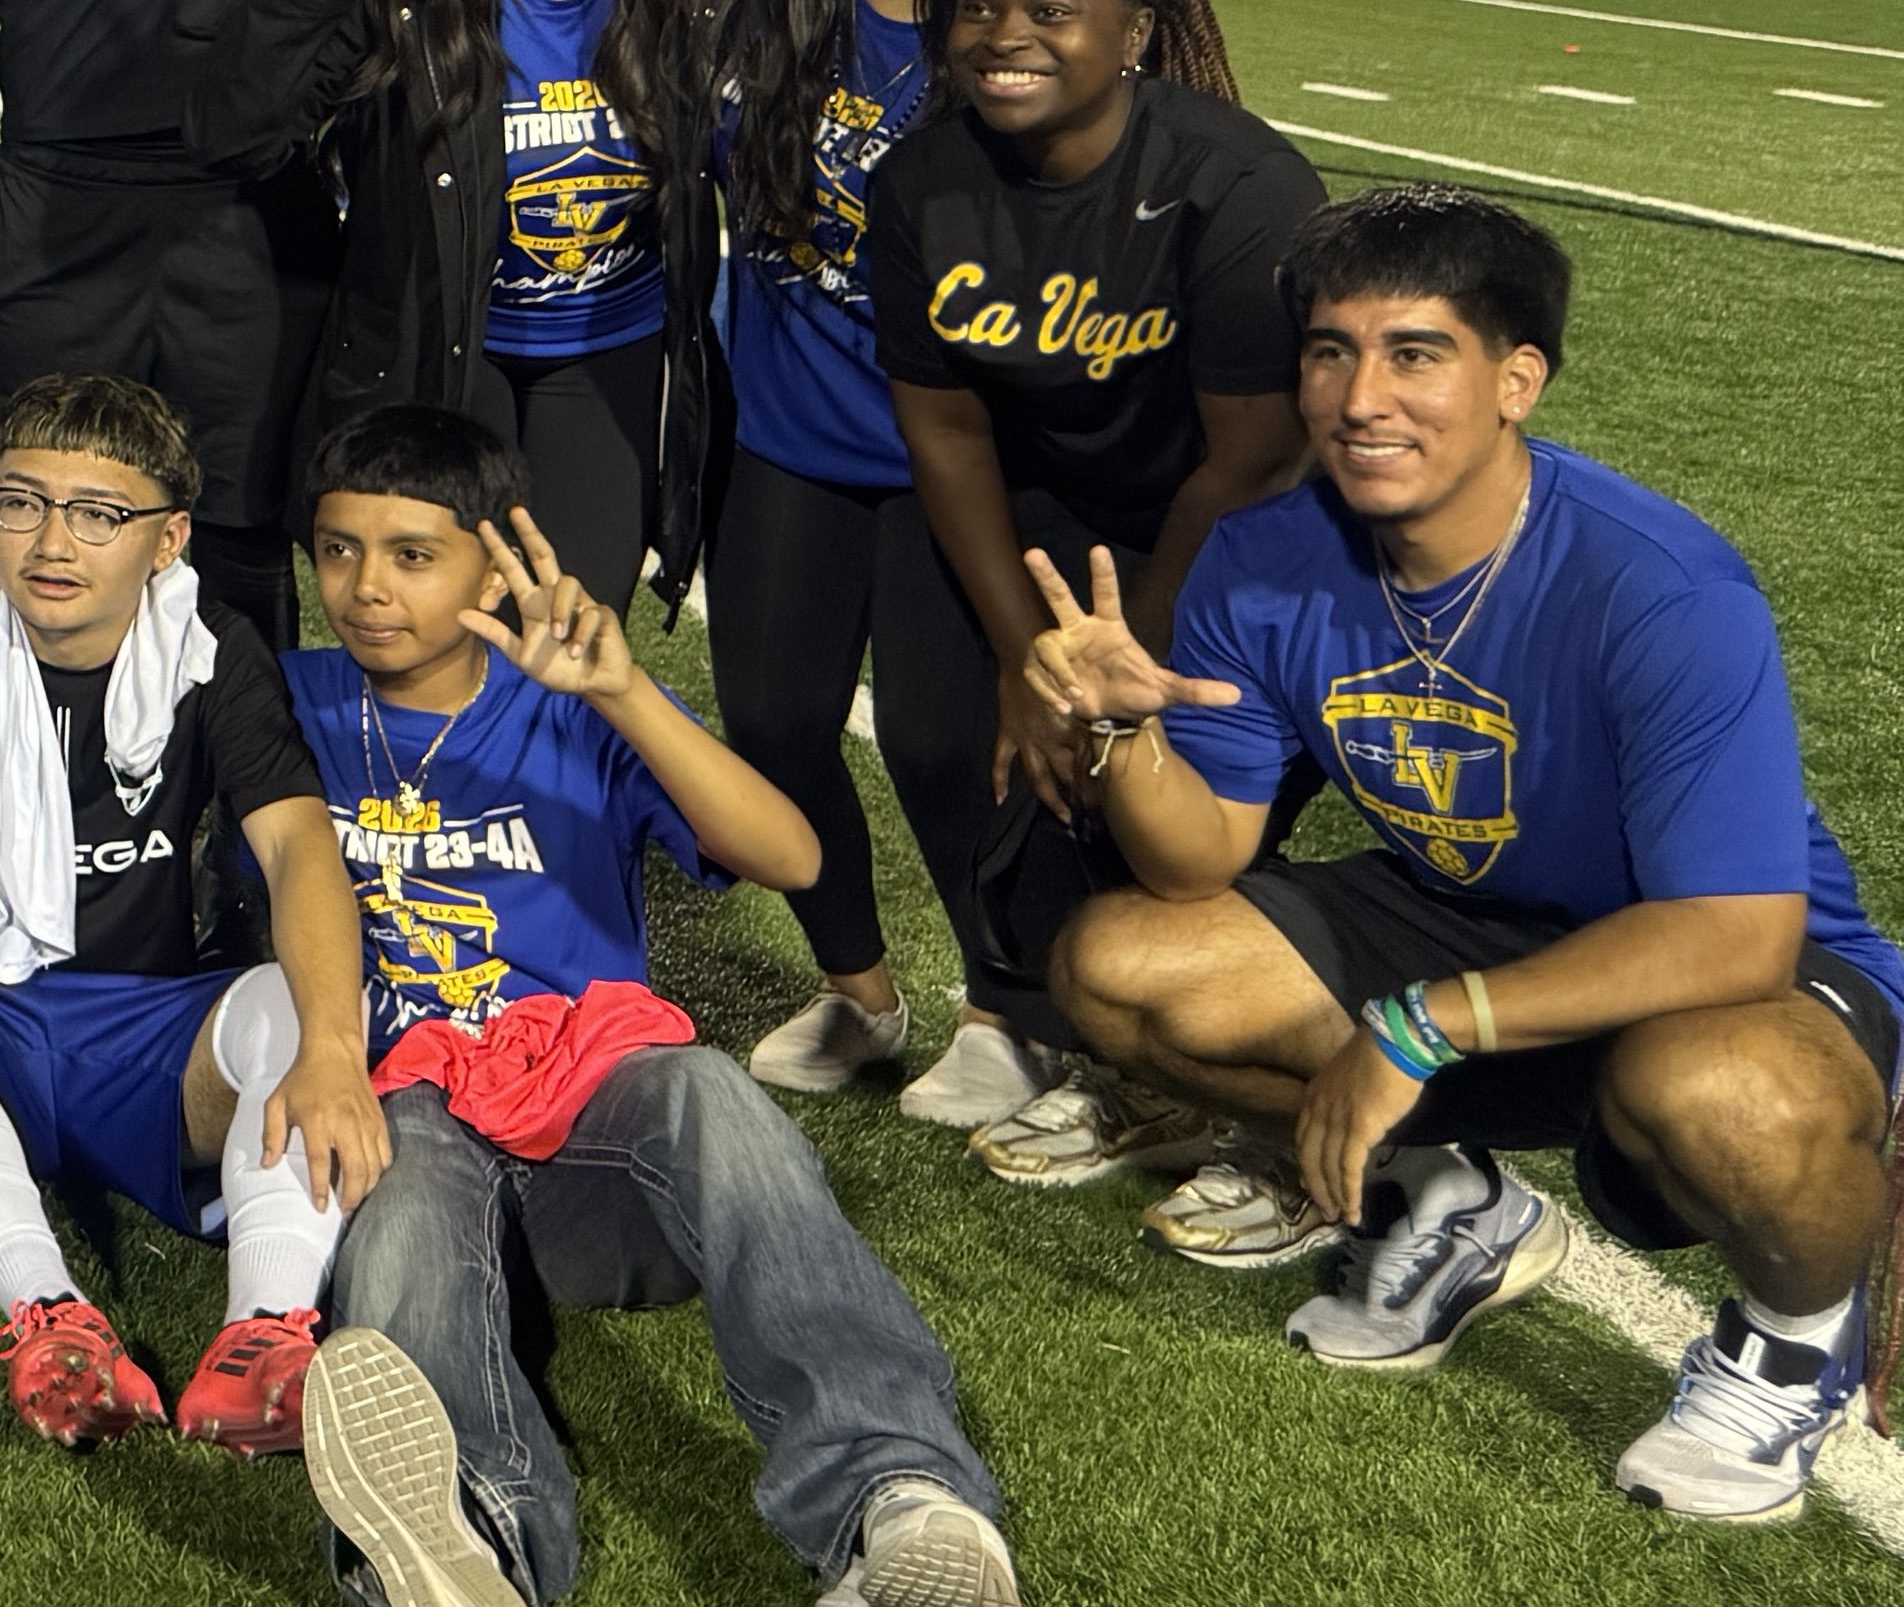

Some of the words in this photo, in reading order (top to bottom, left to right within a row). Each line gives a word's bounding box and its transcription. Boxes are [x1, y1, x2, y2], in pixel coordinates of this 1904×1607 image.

[1038, 272, 1177, 381] Vega
[1360, 697, 1399, 716] LA
[1405, 702, 1479, 729] VEGA
[1391, 721, 1461, 814] LV
[75, 829, 175, 875] EGA
[423, 816, 545, 874] 23-4A
